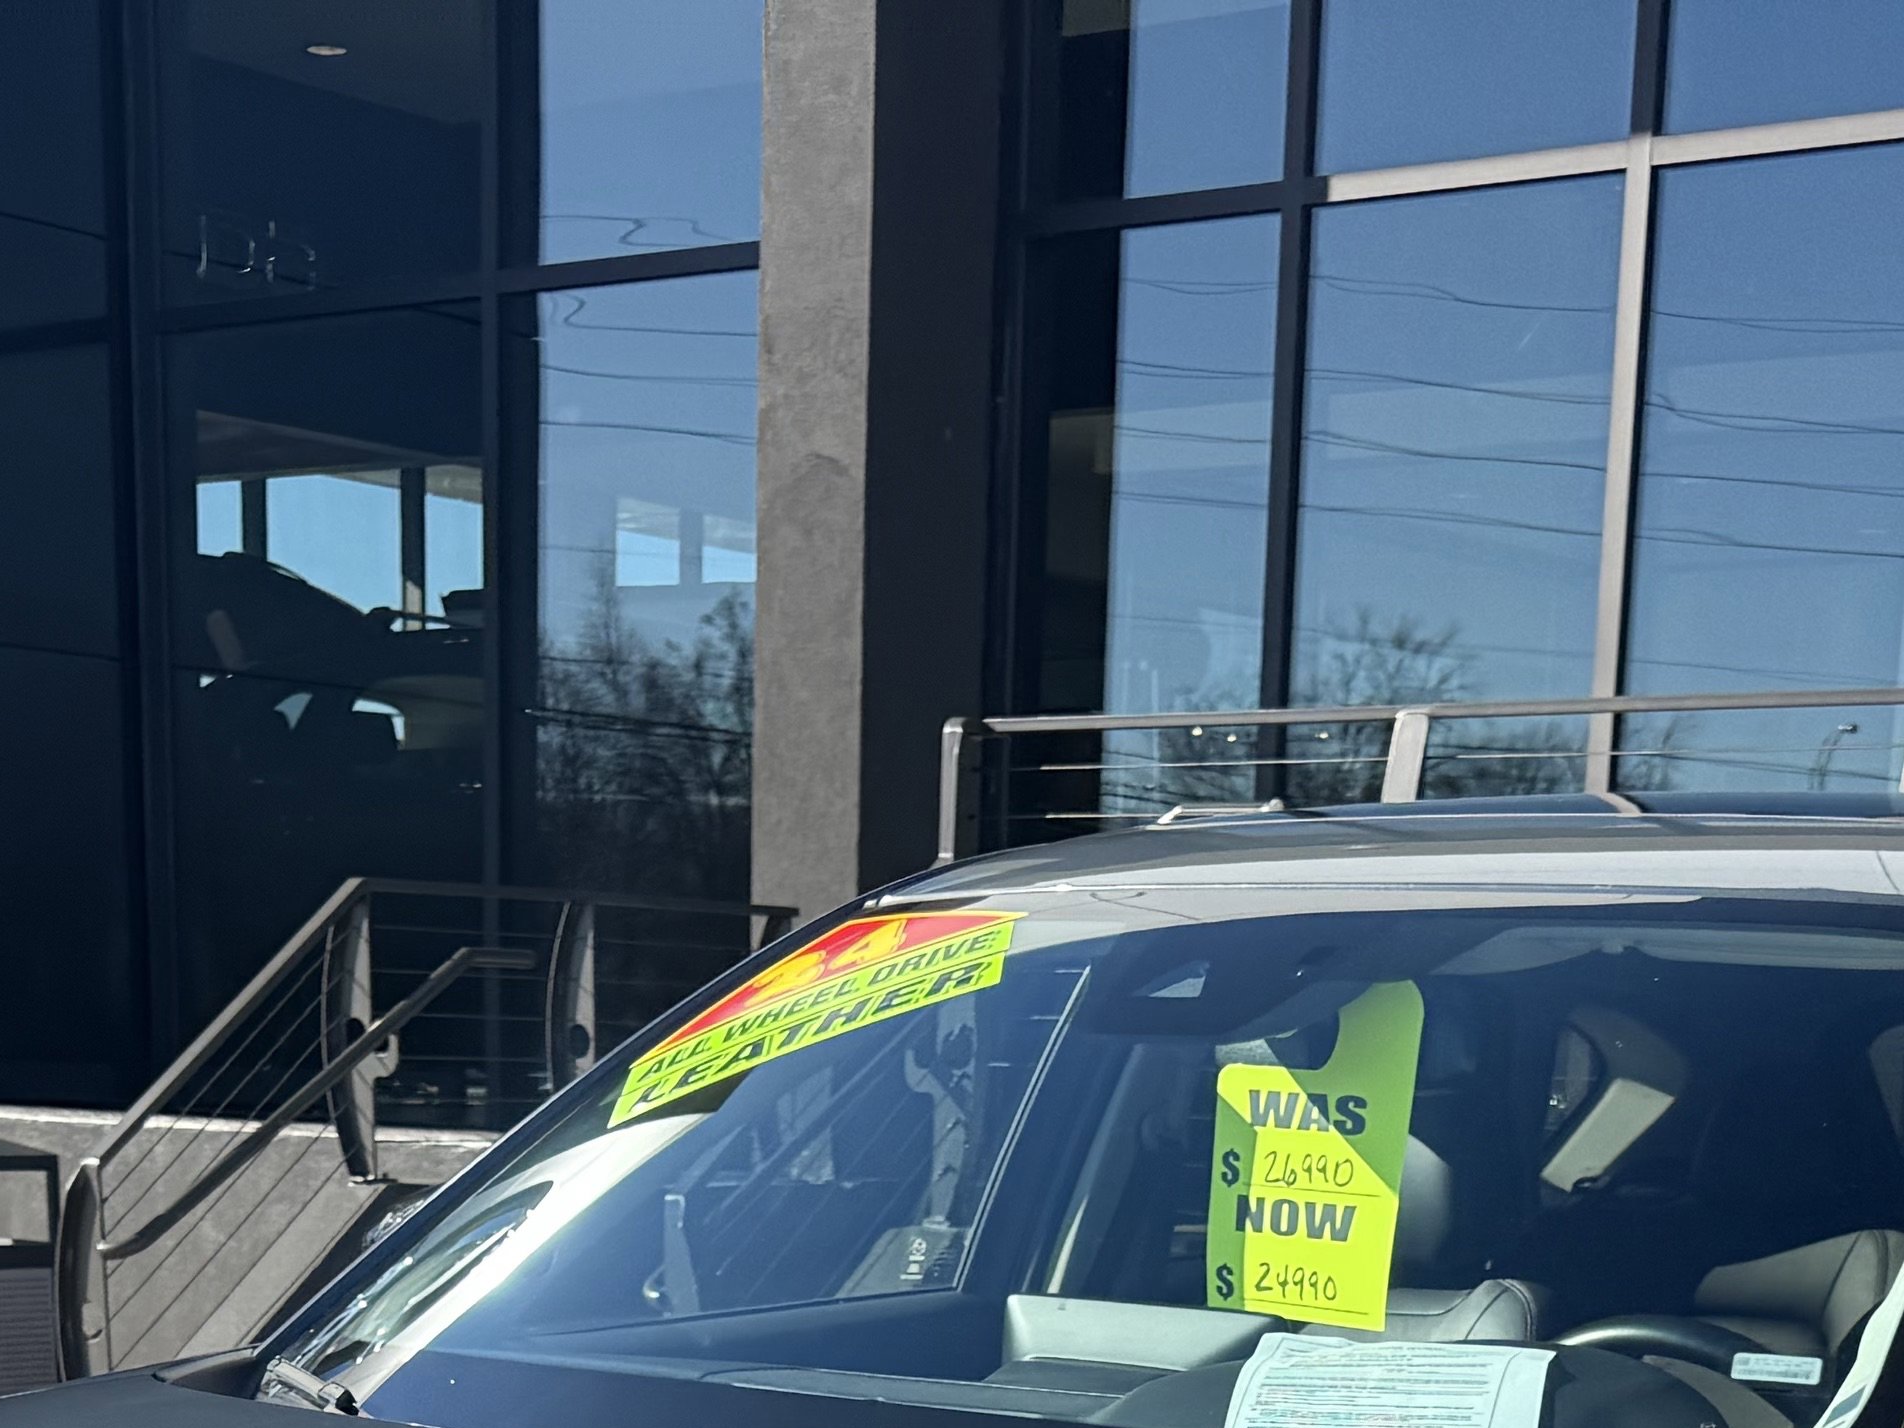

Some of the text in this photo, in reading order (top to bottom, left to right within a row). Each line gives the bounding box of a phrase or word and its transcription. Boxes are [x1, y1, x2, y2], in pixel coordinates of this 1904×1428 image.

[637, 931, 1002, 1084] ALL WHEEL DRIVE
[627, 962, 991, 1113] LEATHER
[1248, 1089, 1368, 1136] WAS
[1221, 1148, 1354, 1188] $ 26990
[1235, 1194, 1357, 1242] NOW
[1215, 1261, 1338, 1301] $ 24990
